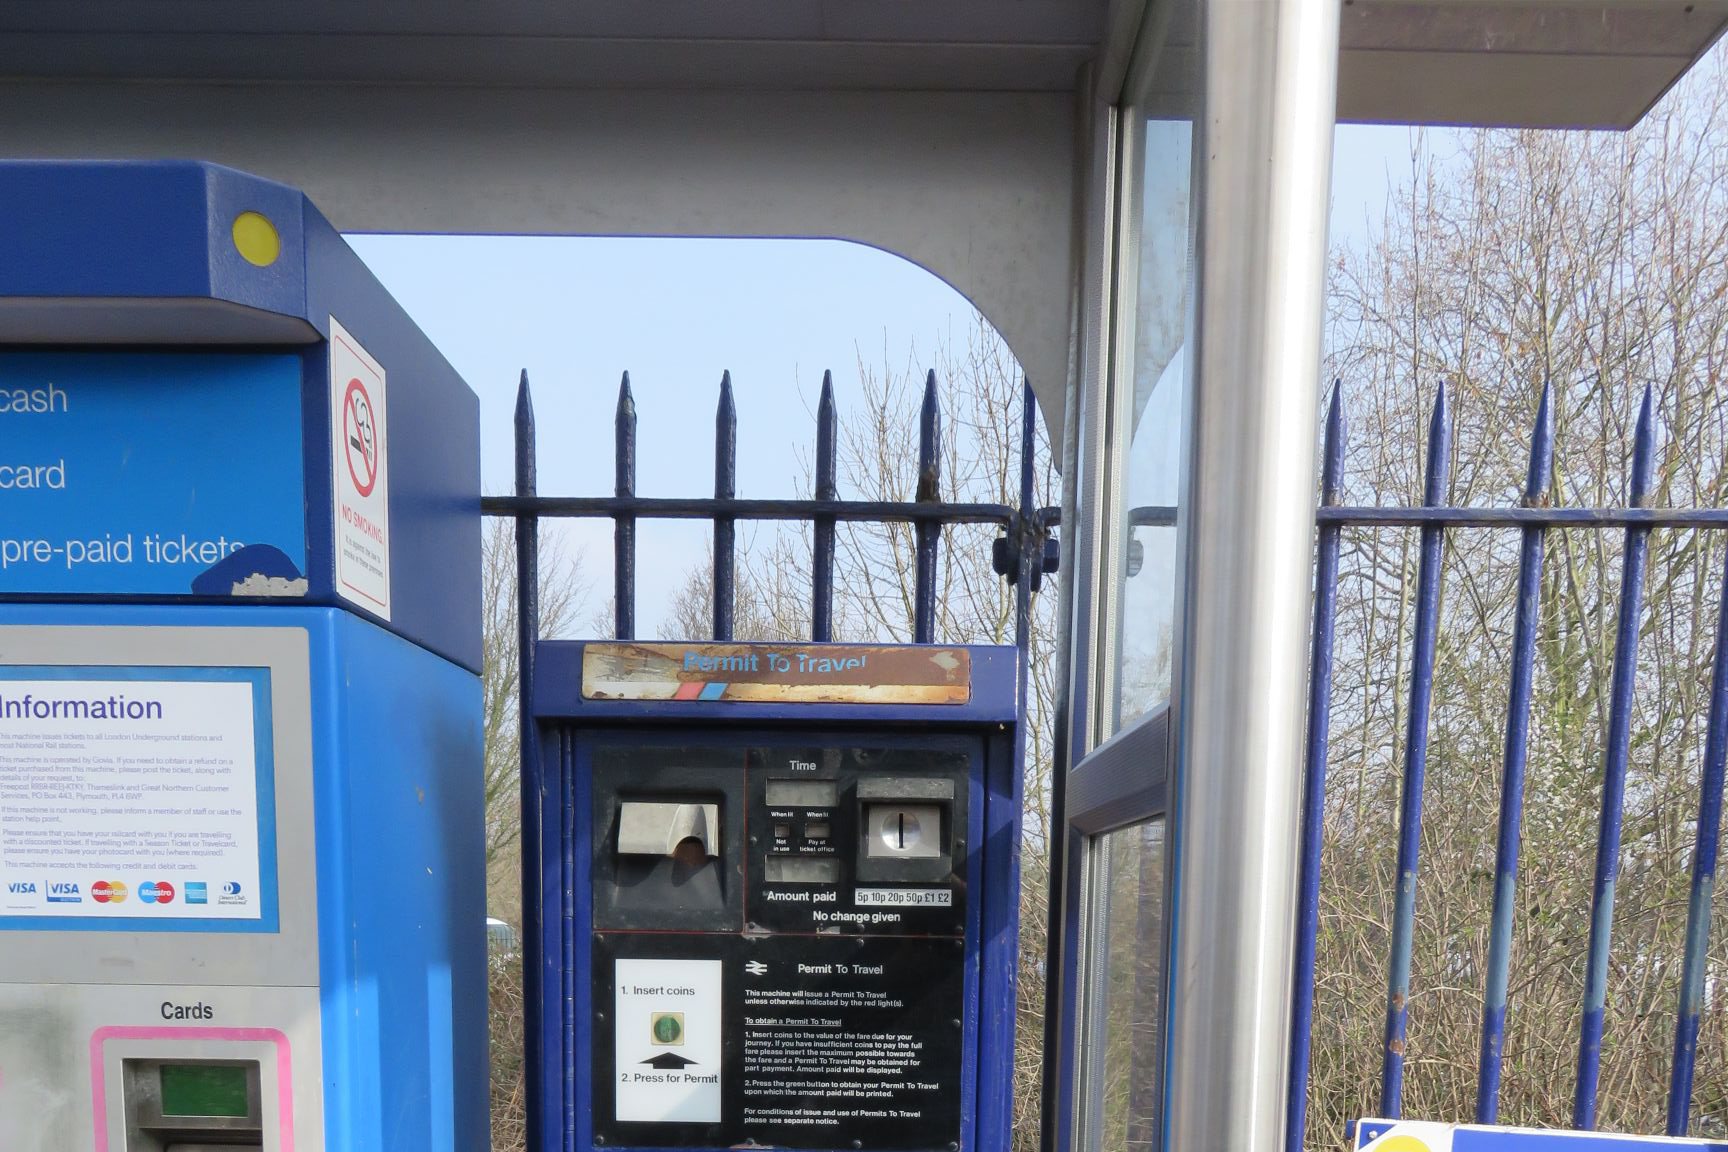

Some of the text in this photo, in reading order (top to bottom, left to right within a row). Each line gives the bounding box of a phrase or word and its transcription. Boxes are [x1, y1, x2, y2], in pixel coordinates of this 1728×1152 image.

[0, 383, 67, 412] cash
[0, 459, 65, 488] card
[342, 503, 353, 523] NO
[1, 533, 132, 569] pre-paid
[683, 651, 867, 673] Permit To Travel
[0, 694, 162, 719] Information
[789, 759, 817, 771] Time
[8, 882, 37, 893] VISA
[51, 883, 80, 894] VISA
[767, 890, 837, 904] Amount paid
[857, 892, 950, 904] 5p 10p 20p 50p £1 £2
[812, 911, 901, 924] No change given
[798, 963, 882, 975] Permit To Travel
[621, 985, 695, 996] 1. Insert coins
[745, 989, 760, 997] This
[804, 990, 822, 998] issue
[865, 991, 886, 999] Travel
[877, 999, 903, 1008] light(s).
[160, 1001, 213, 1020] Cards
[885, 1033, 895, 1041] for
[897, 1034, 912, 1042] your
[621, 1073, 718, 1084] 2. Press for Permit
[916, 1082, 938, 1090] Travel
[826, 1089, 841, 1097] paid
[865, 1090, 893, 1098] printed.
[757, 1108, 793, 1116] conditions
[899, 1110, 920, 1118] Travel
[783, 1117, 814, 1125] separate
